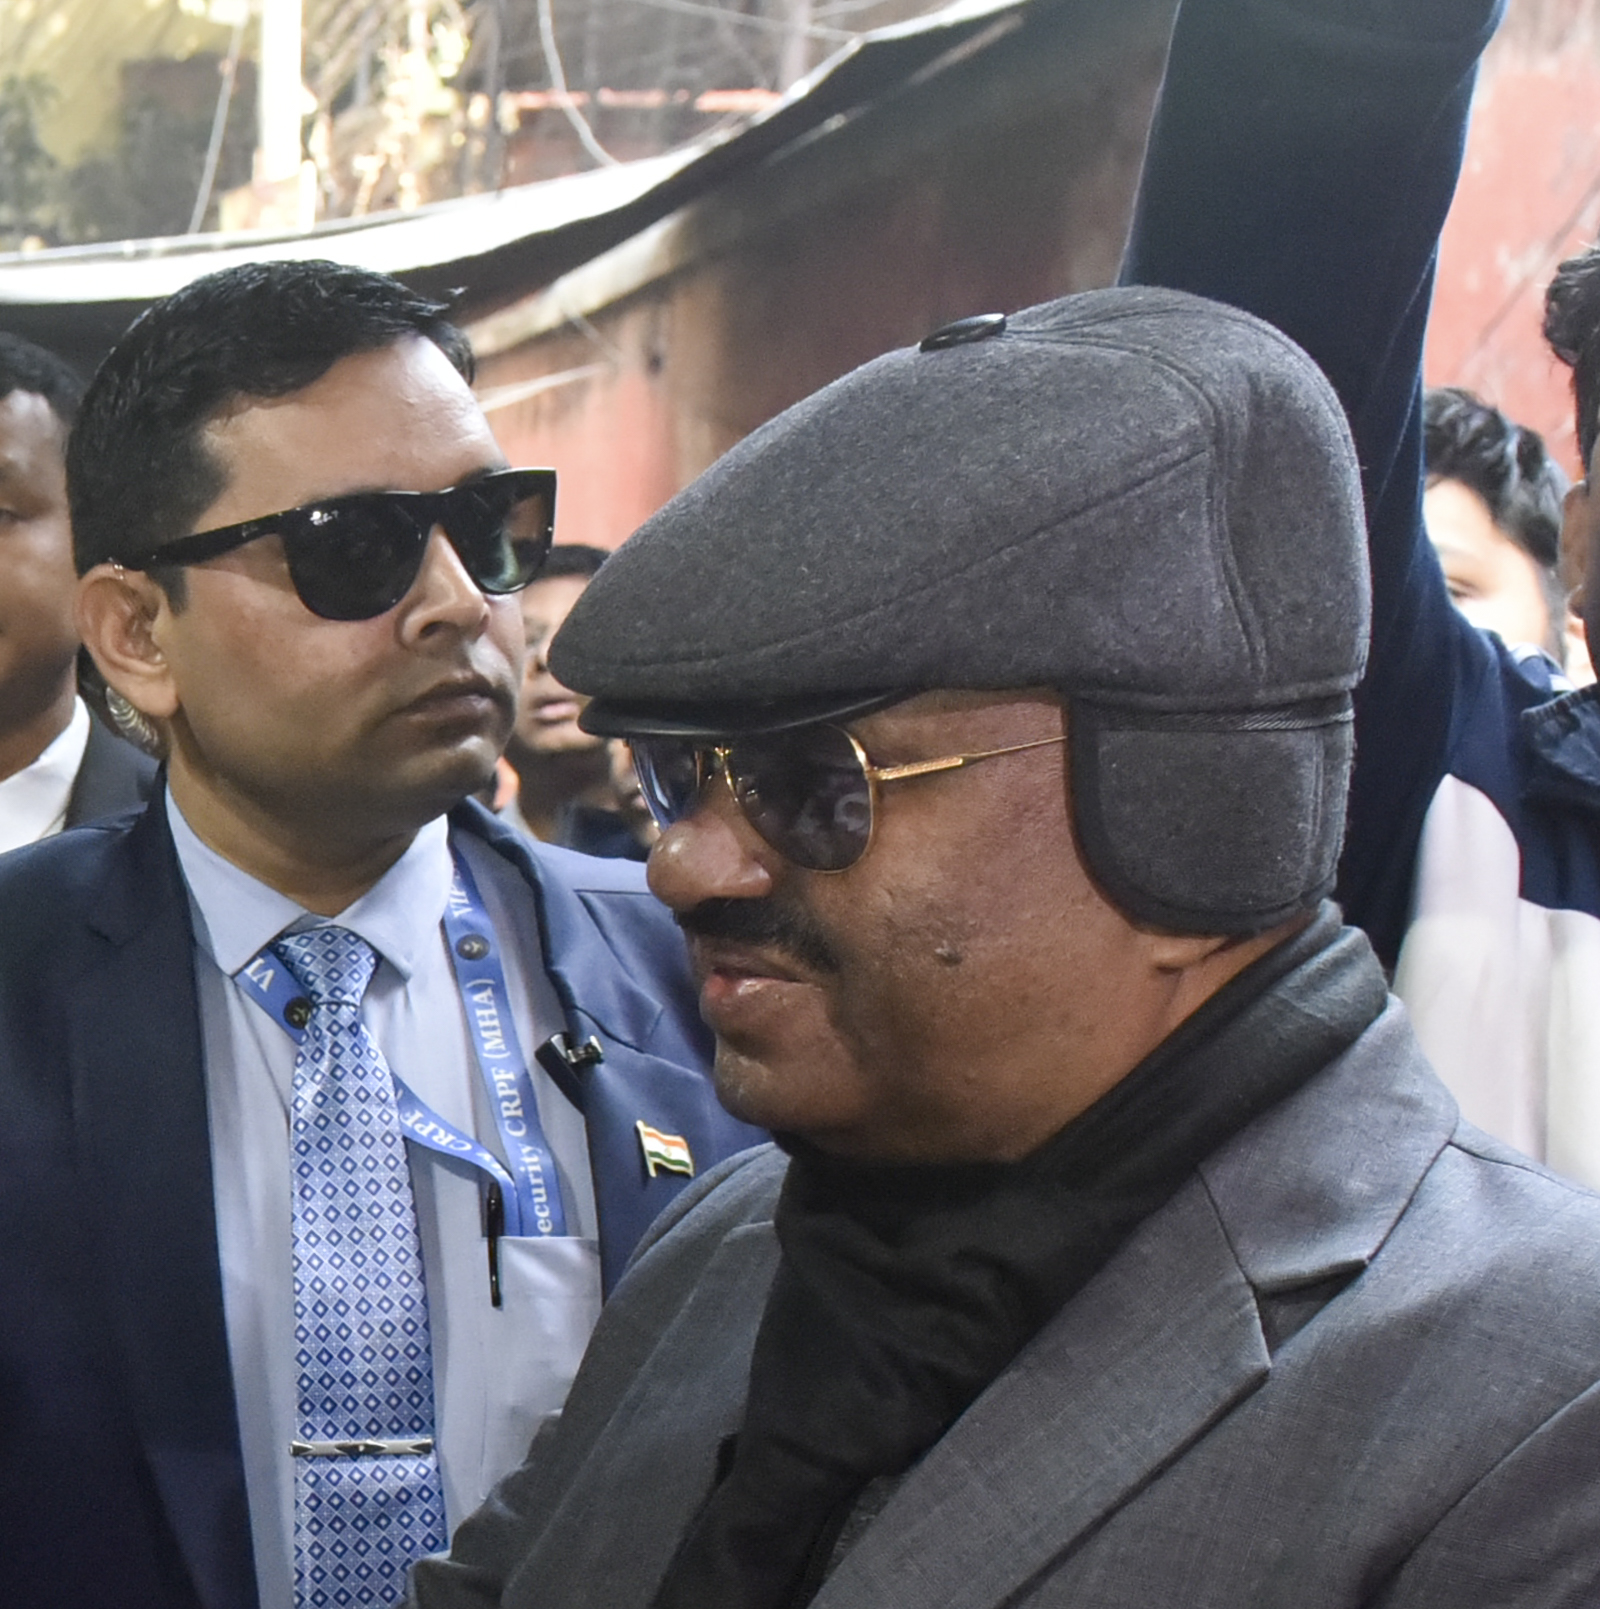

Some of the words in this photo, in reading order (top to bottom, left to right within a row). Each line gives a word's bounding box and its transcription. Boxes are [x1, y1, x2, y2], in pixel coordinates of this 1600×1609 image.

[465, 978, 511, 1060] (MHA)
[491, 1066, 528, 1138] CRPF
[518, 1142, 554, 1236] ecurity
